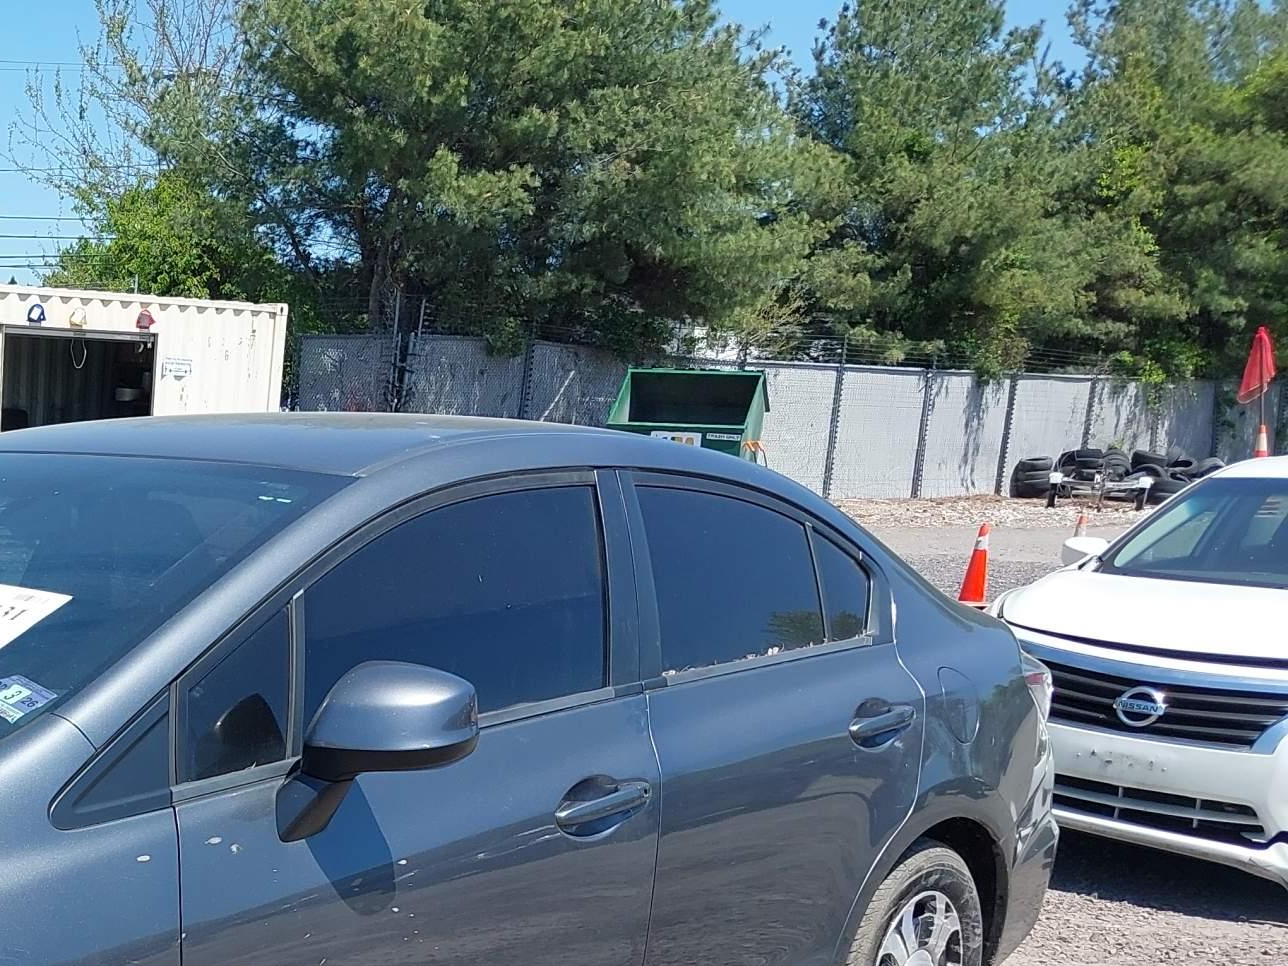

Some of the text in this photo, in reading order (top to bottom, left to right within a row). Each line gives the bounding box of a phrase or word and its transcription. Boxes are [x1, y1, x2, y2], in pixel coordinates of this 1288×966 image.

[4, 690, 22, 700] 3
[20, 697, 39, 708] 26
[1119, 702, 1159, 712] NISSAN
